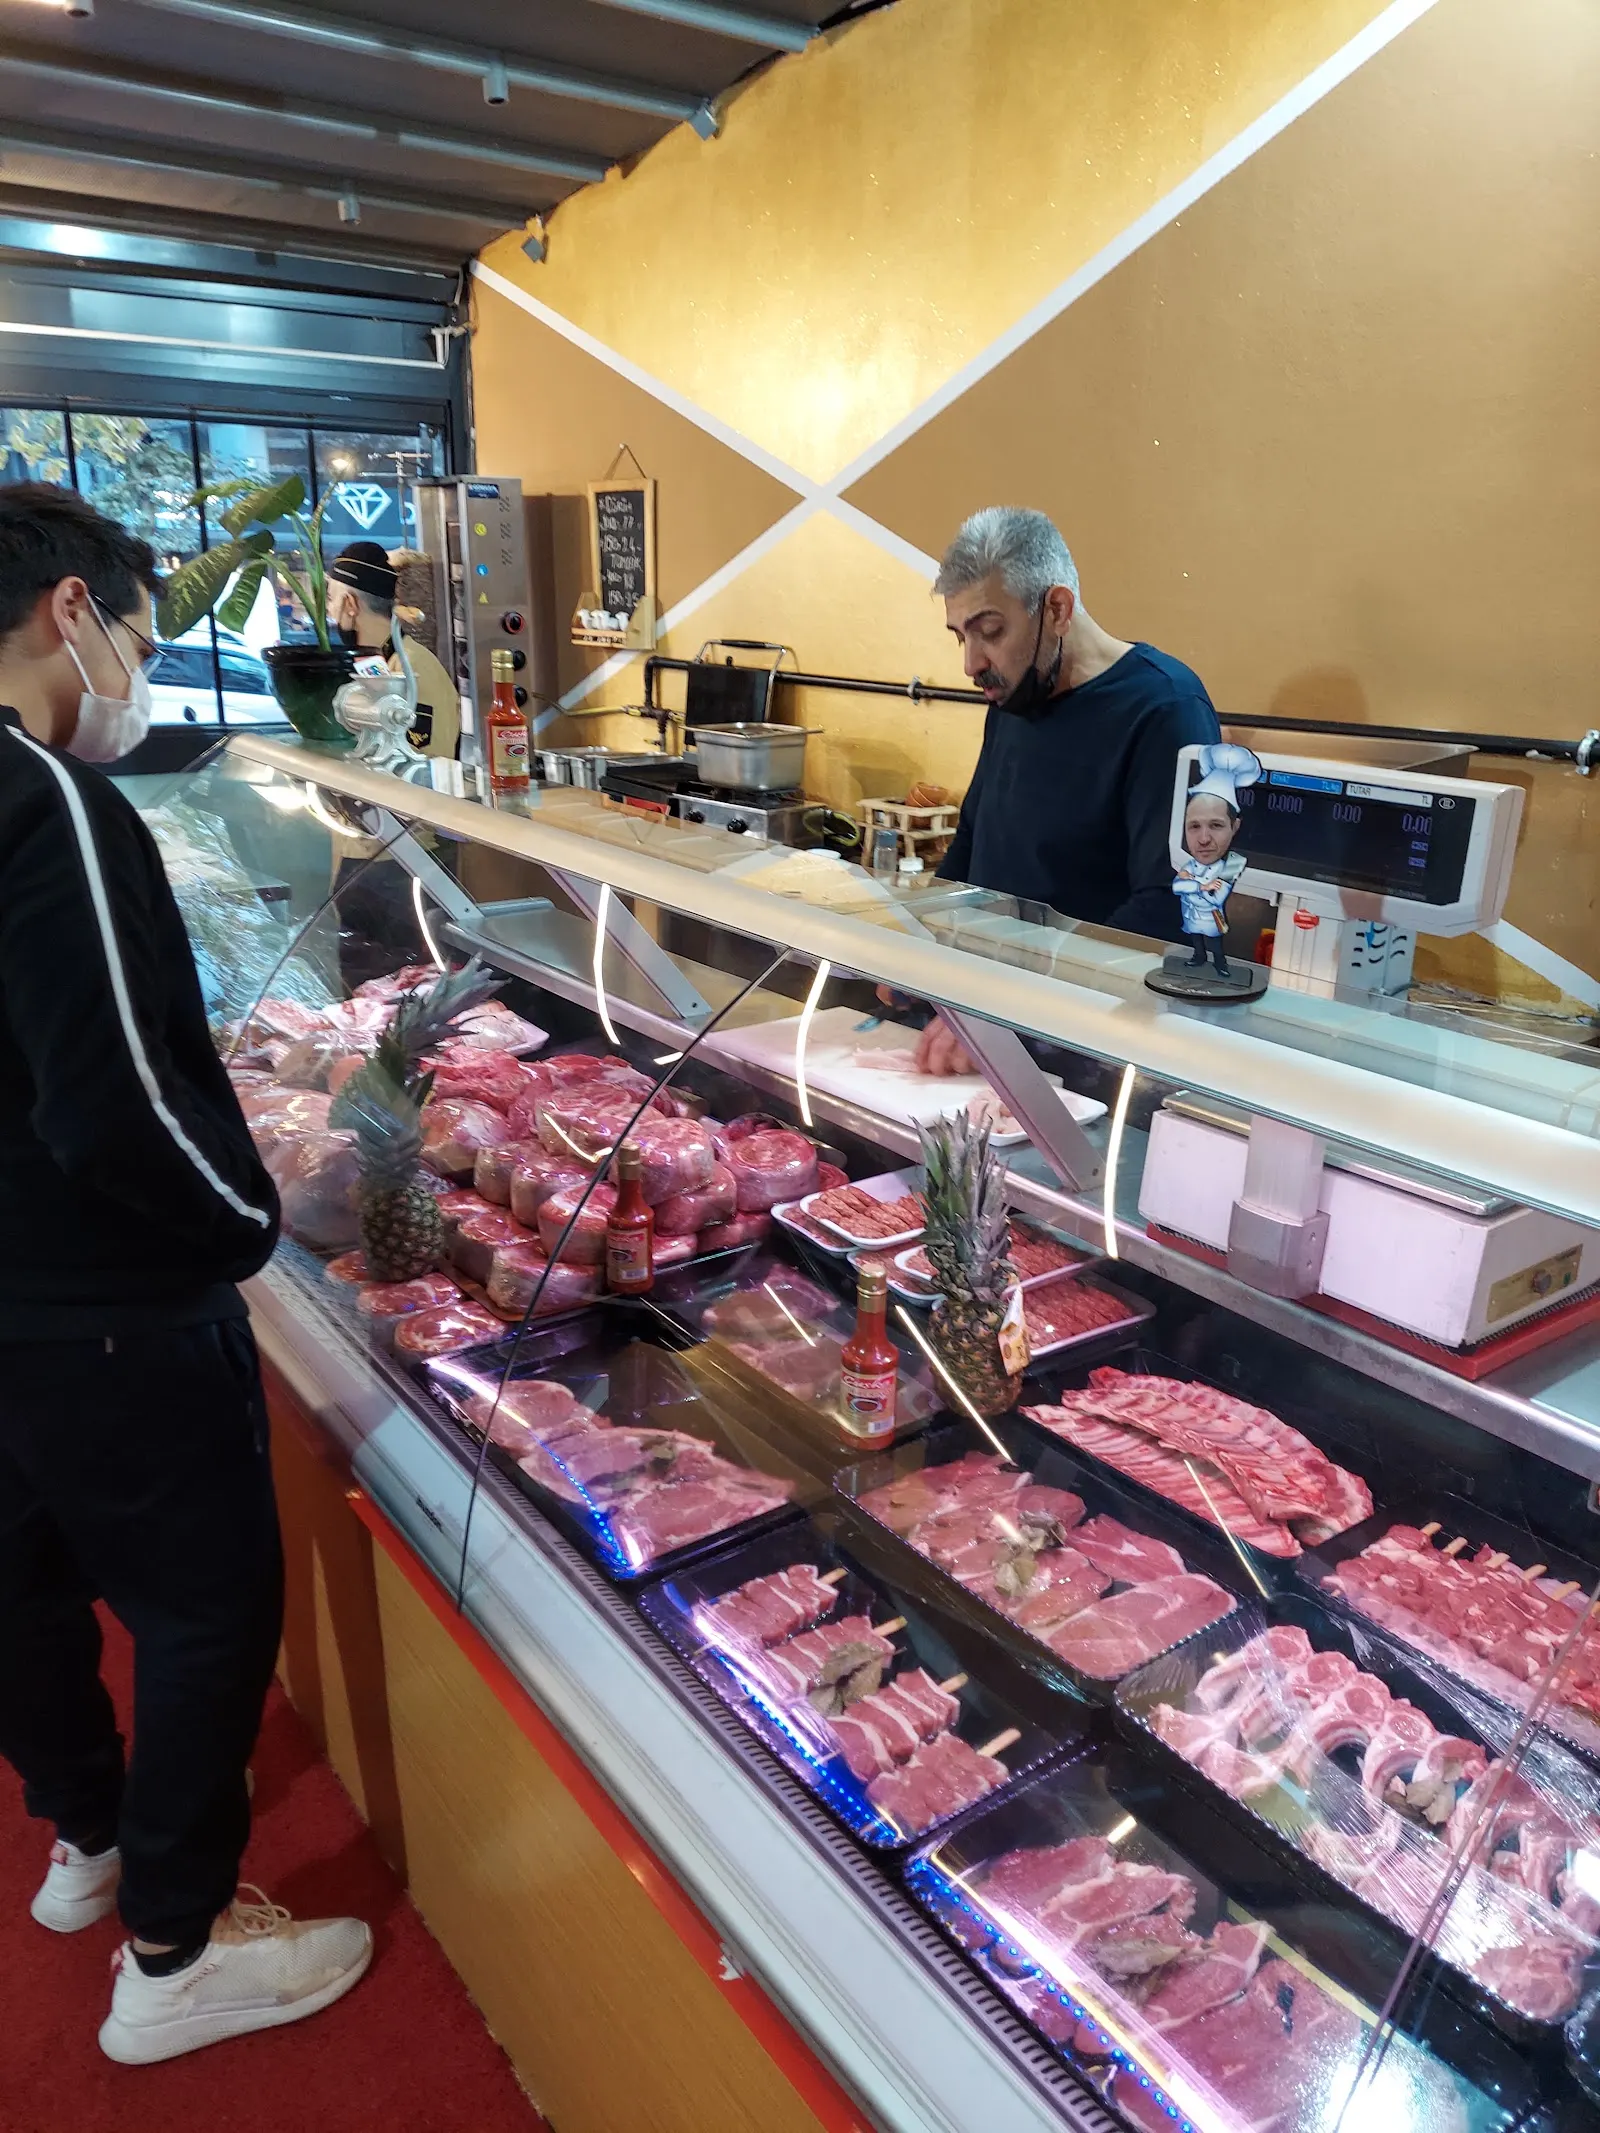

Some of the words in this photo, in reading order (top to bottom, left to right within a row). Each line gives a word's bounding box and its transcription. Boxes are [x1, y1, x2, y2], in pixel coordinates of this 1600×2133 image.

[1349, 784, 1371, 796] TUTAR
[1421, 795, 1430, 805] TL
[1267, 792, 1304, 815] 0.000
[1332, 802, 1361, 824] 0.00
[1402, 813, 1432, 836] 0.00
